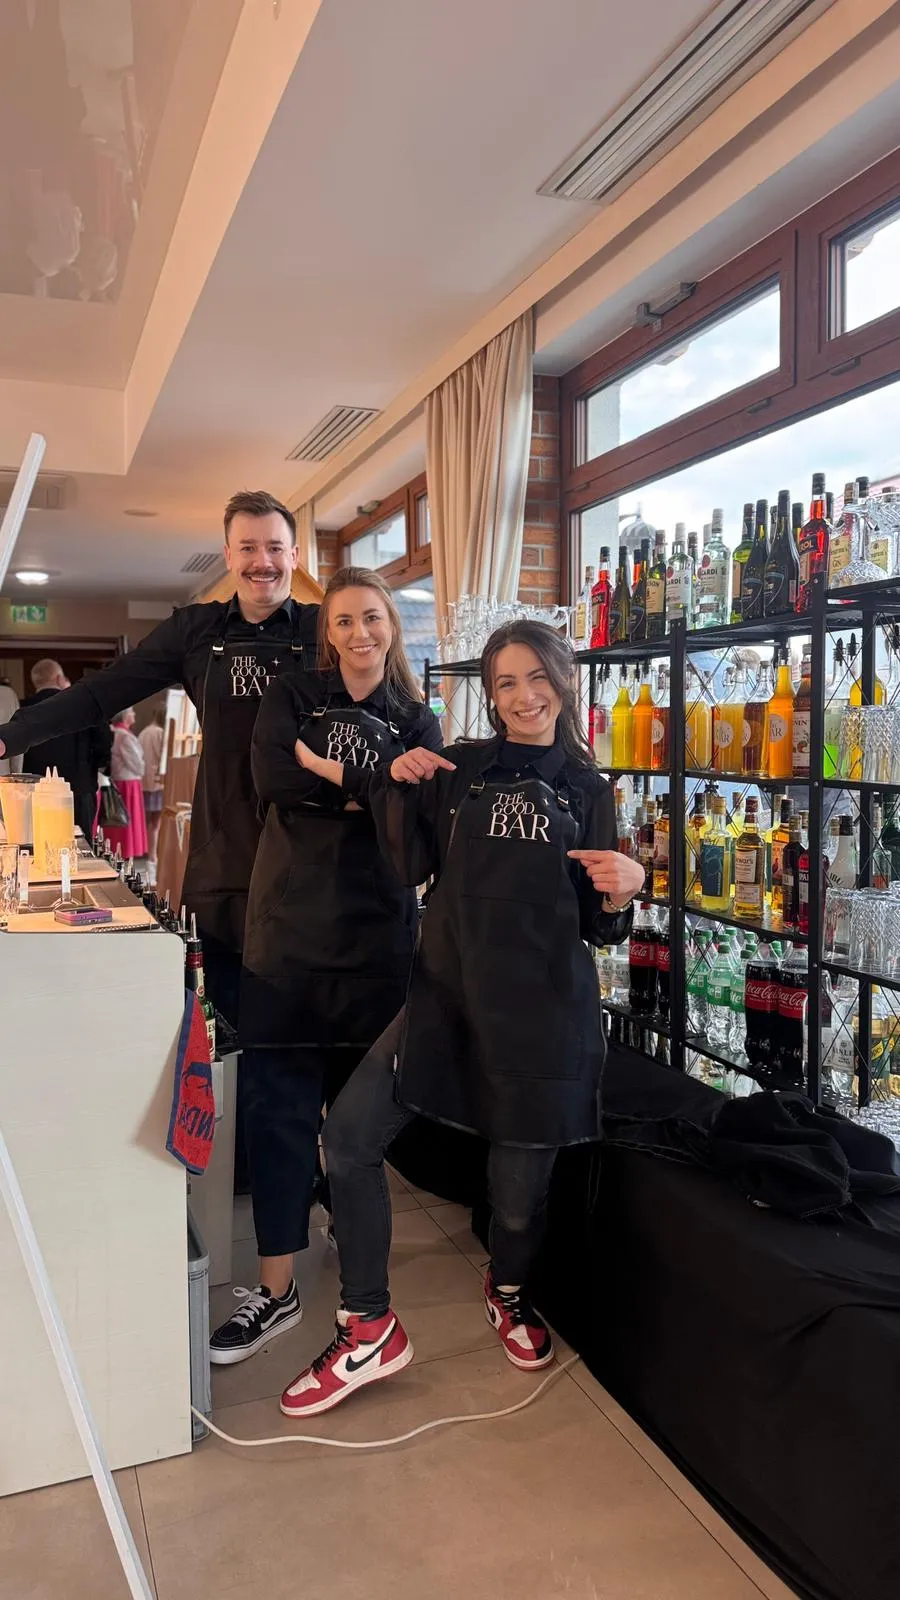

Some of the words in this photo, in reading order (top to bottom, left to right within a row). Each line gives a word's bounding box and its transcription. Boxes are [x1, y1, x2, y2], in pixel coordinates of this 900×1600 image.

[232, 656, 257, 667] THE
[231, 665, 267, 677] GOOD
[331, 721, 360, 737] THE
[328, 731, 367, 749] GOOD
[327, 741, 379, 771] BAR
[495, 791, 525, 805] THE
[492, 801, 535, 815] GOOD
[486, 811, 551, 843] BAR
